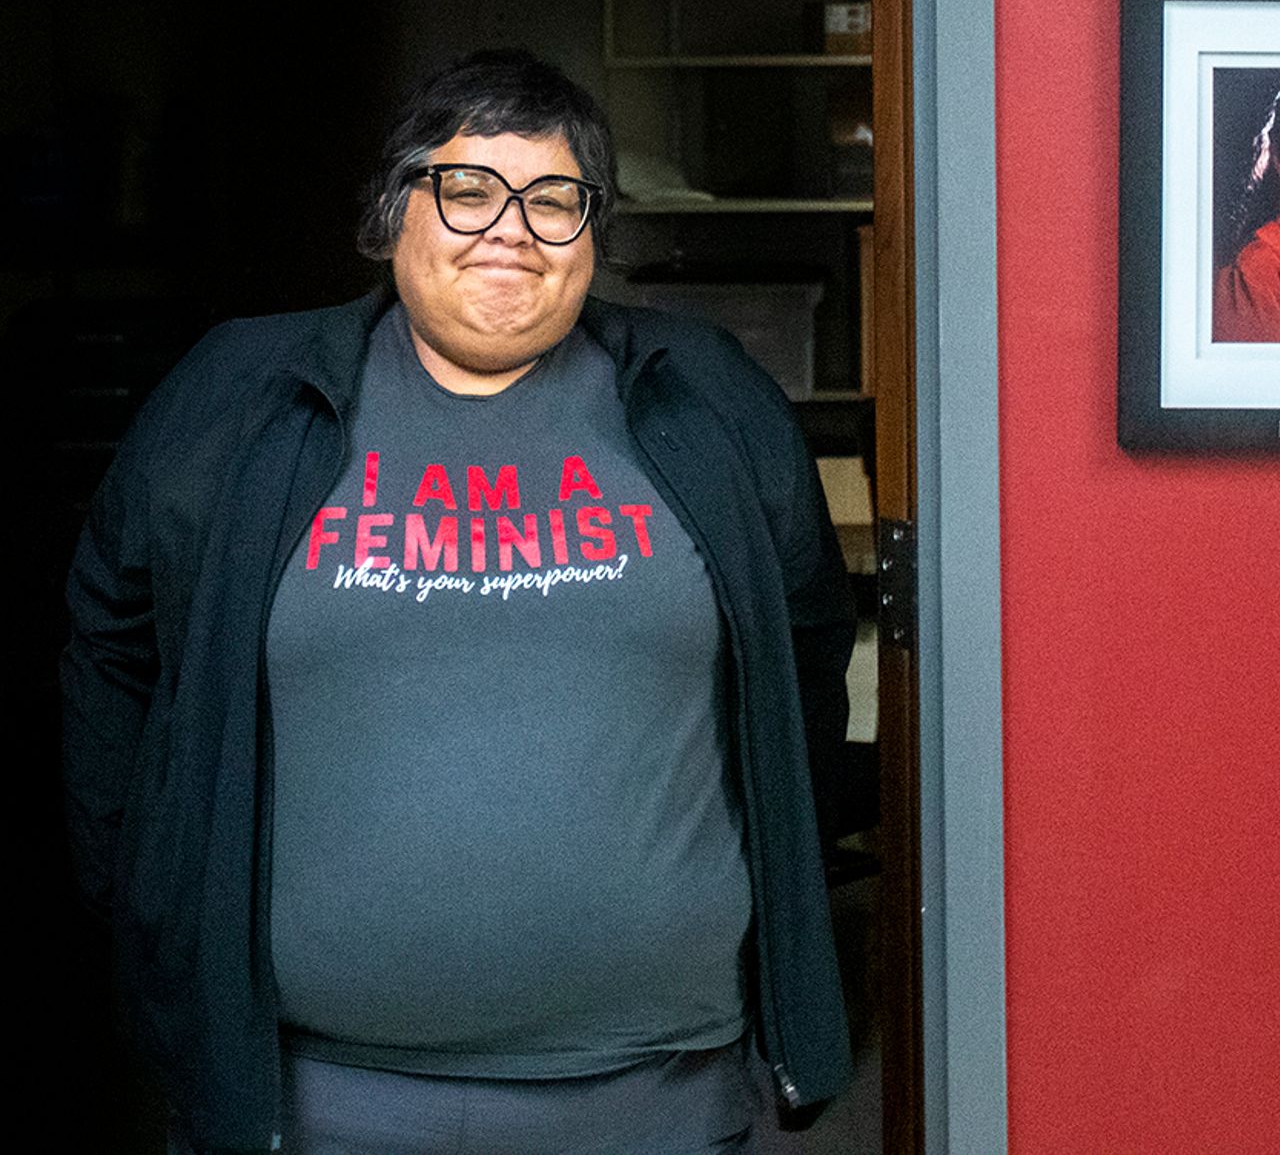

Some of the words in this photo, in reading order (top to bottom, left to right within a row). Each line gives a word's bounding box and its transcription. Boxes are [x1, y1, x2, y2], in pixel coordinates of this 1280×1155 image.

[362, 451, 380, 507] I
[413, 463, 521, 512] AM
[558, 455, 603, 501] A
[305, 504, 654, 573] FEMINIST
[333, 556, 411, 593] What's
[416, 572, 475, 603] your
[480, 554, 629, 600] superpower?
